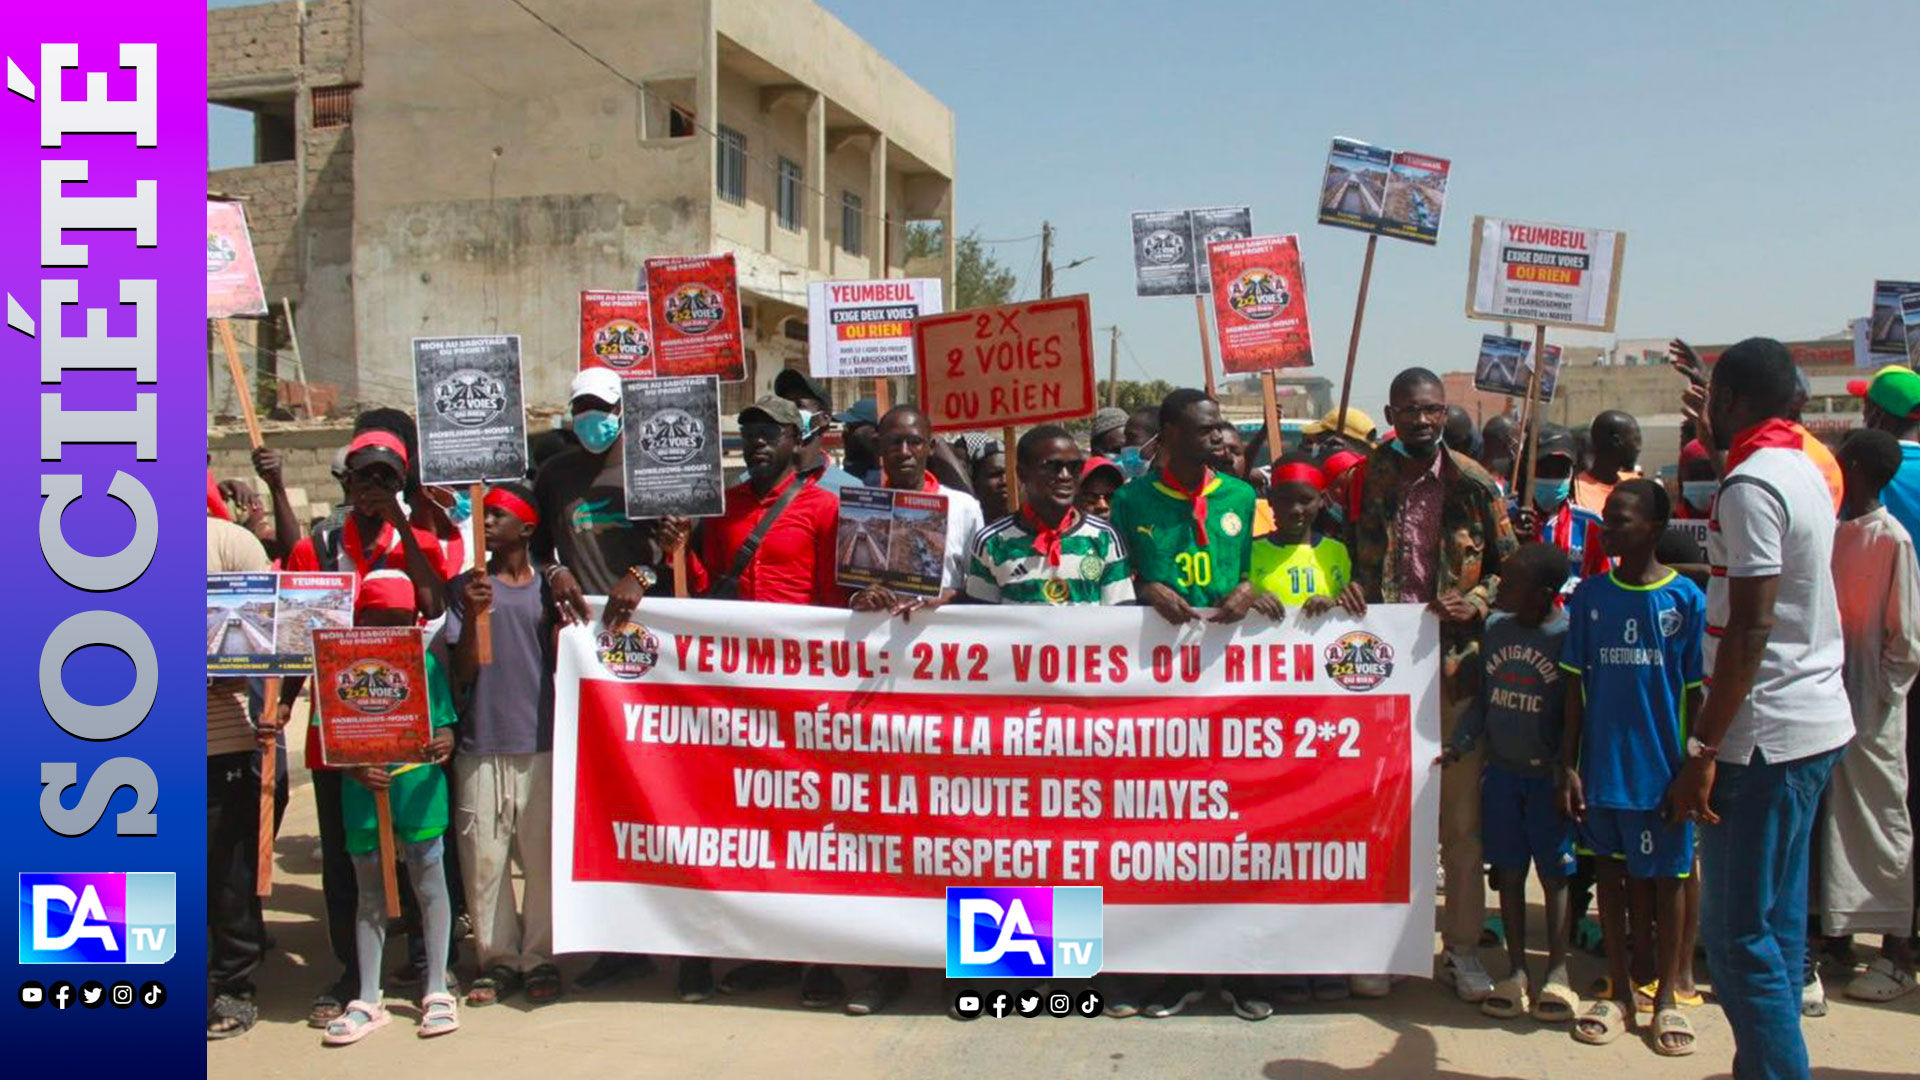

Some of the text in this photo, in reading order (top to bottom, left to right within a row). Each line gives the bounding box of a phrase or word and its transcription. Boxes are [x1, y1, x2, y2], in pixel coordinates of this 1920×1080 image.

[1509, 225, 1587, 250] YEUMBEUL
[1507, 250, 1584, 268] EXIGE DEUX VOIES
[1517, 266, 1570, 282] OU RIEN
[832, 283, 914, 302] YEUMBEUL
[1258, 293, 1282, 303] VOIES
[692, 309, 717, 318] VOIES
[834, 308, 914, 322] EXIGE DEUX VOIES
[846, 324, 901, 338] OU RIEN
[948, 335, 1062, 377] 2 VOIES
[445, 398, 497, 410] 2x2 VOIES
[945, 392, 979, 419] OU
[648, 436, 696, 448] 2x2 VOIES
[1176, 553, 1211, 587] 30
[1288, 568, 1314, 593] 11
[1624, 619, 1638, 644] 8
[675, 634, 1314, 683] YEUMBEUL: 2X2 VOIES OU RIEN
[1332, 663, 1386, 675] 2x2 VOIES
[1486, 644, 1560, 684] NAVIGATION
[369, 688, 400, 697] VOIES
[1490, 688, 1543, 712] ARCTIC
[624, 703, 785, 748] YEUMBEUL
[795, 703, 943, 755] RÉCLAME
[953, 717, 990, 756] LA
[1003, 709, 1210, 758] RÉALISATION
[1222, 717, 1283, 758] DES
[734, 768, 1238, 820] VOIES DE LA ROUTE DES NIAYES.
[613, 821, 1367, 881] YEUMBEUL MÉRITE RESPECT ET CONSIDÉRATION
[1640, 830, 1653, 854] 8
